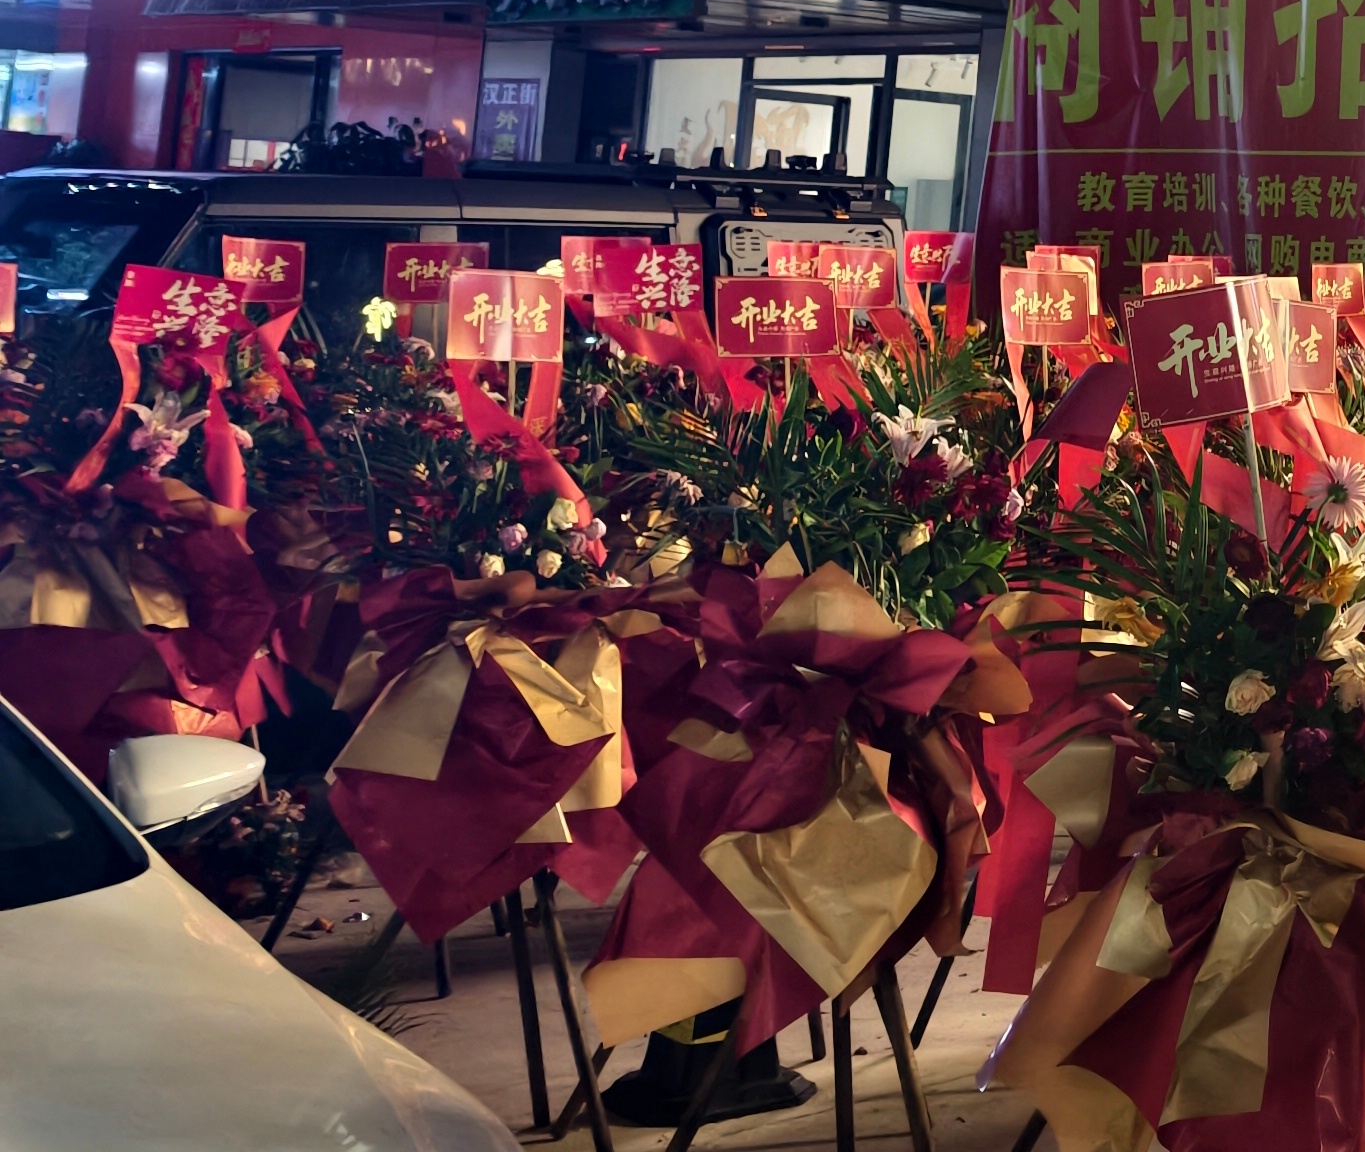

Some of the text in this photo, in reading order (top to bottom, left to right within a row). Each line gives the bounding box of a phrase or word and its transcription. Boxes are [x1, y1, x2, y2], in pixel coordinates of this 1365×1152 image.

[482, 81, 539, 106] 汉正街
[731, 295, 821, 344] 开业大吉
[1011, 286, 1076, 332] 开业大吉
